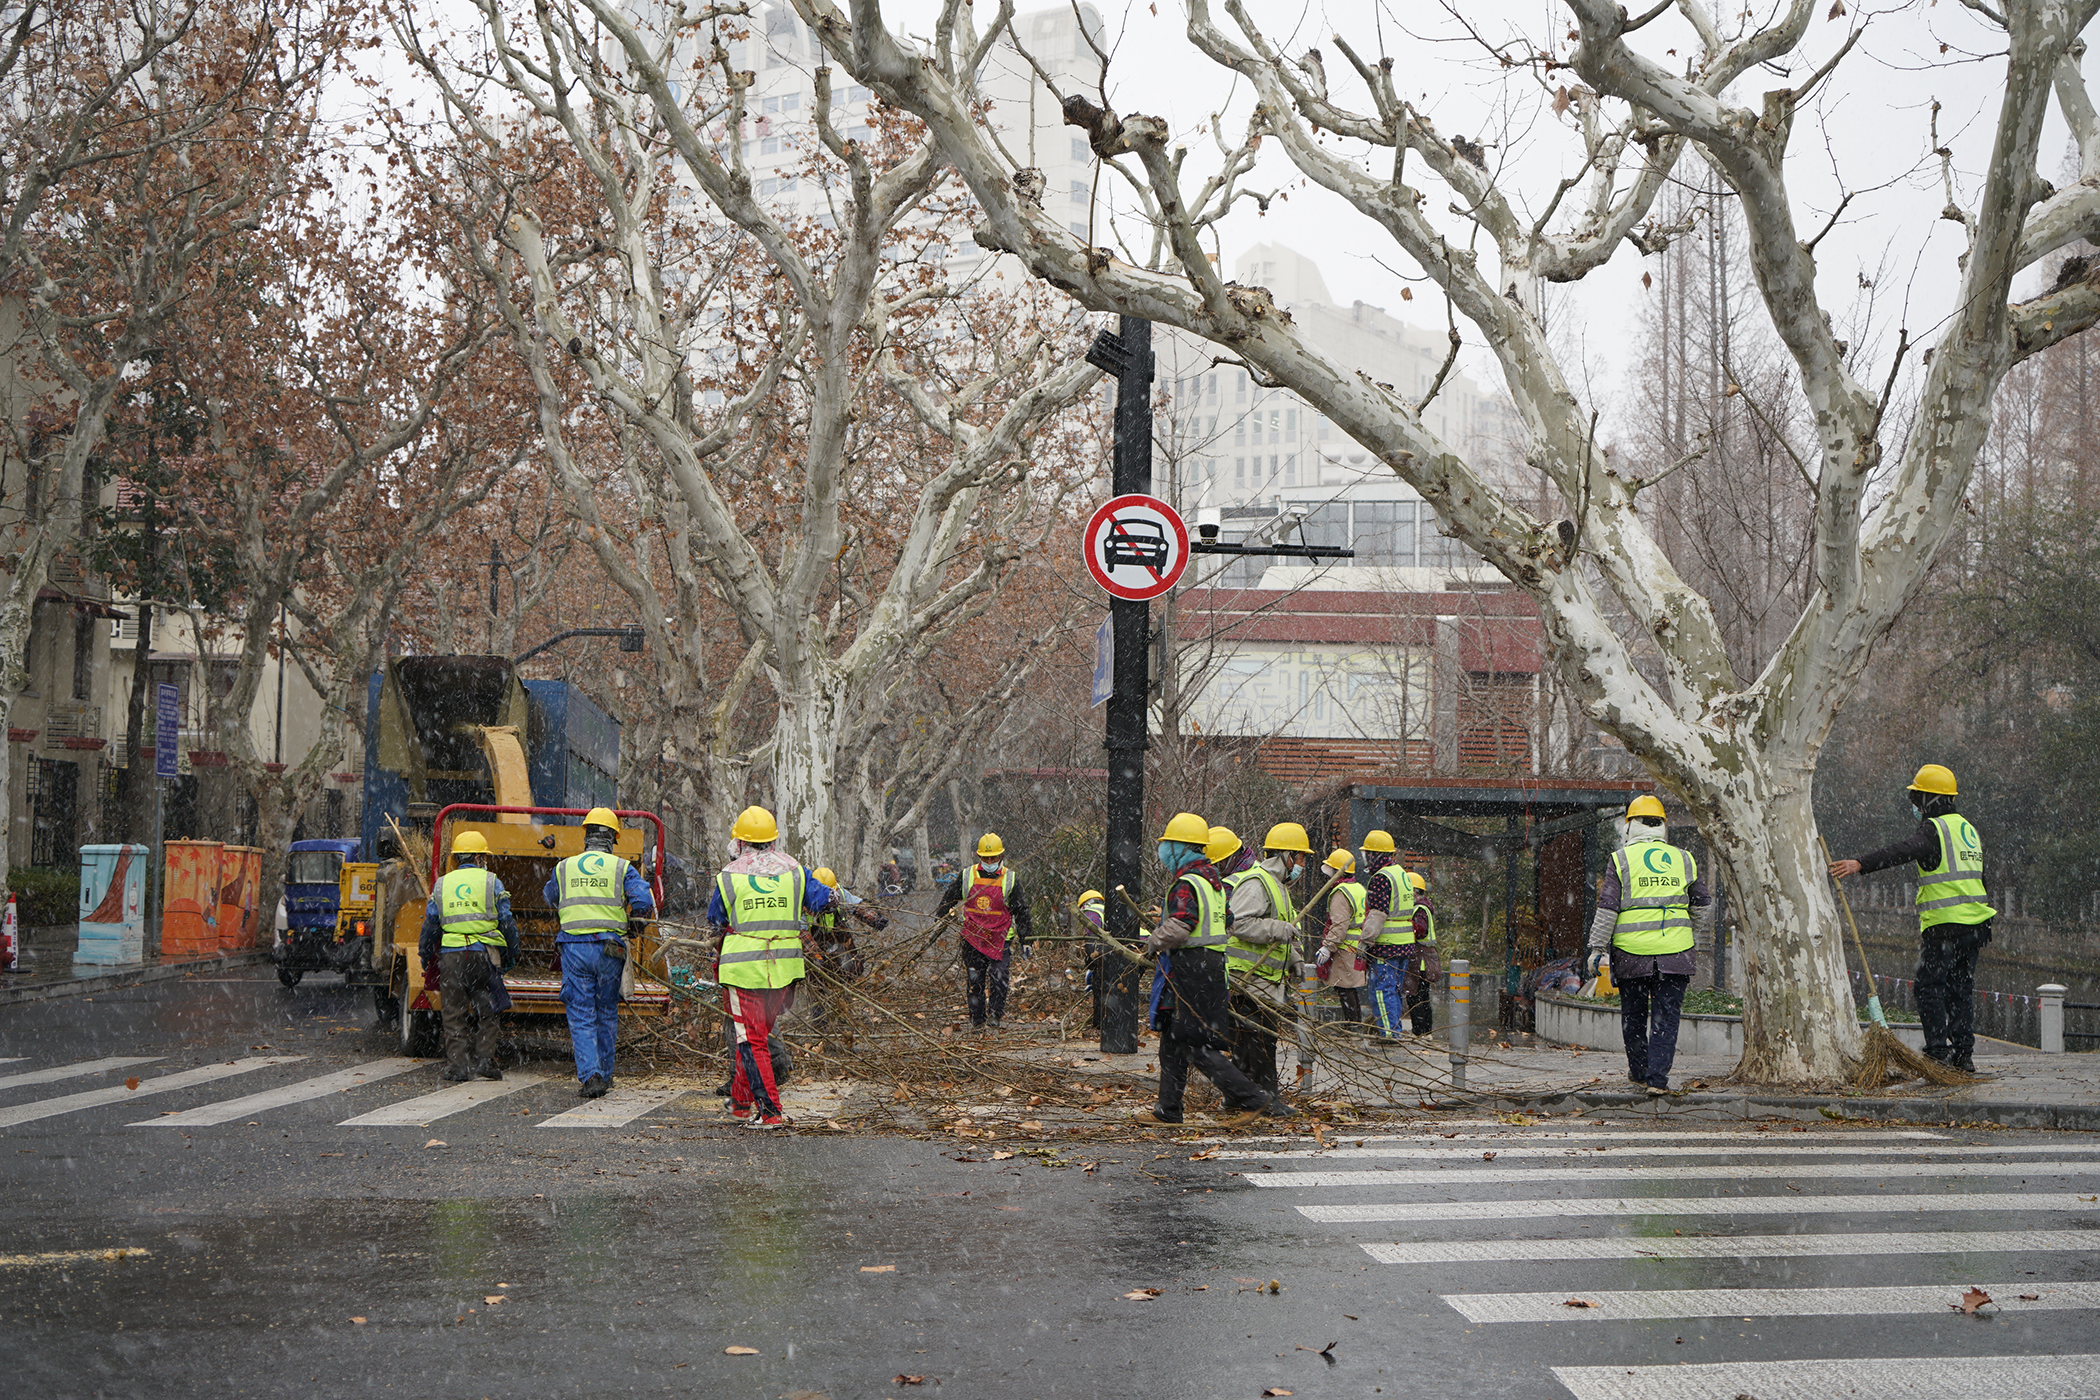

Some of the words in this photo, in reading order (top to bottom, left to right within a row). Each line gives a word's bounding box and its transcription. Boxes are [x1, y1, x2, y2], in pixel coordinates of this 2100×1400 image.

[571, 878, 608, 887] 园开公司
[1639, 877, 1680, 887] 园开公司
[743, 897, 787, 910] 园开公司
